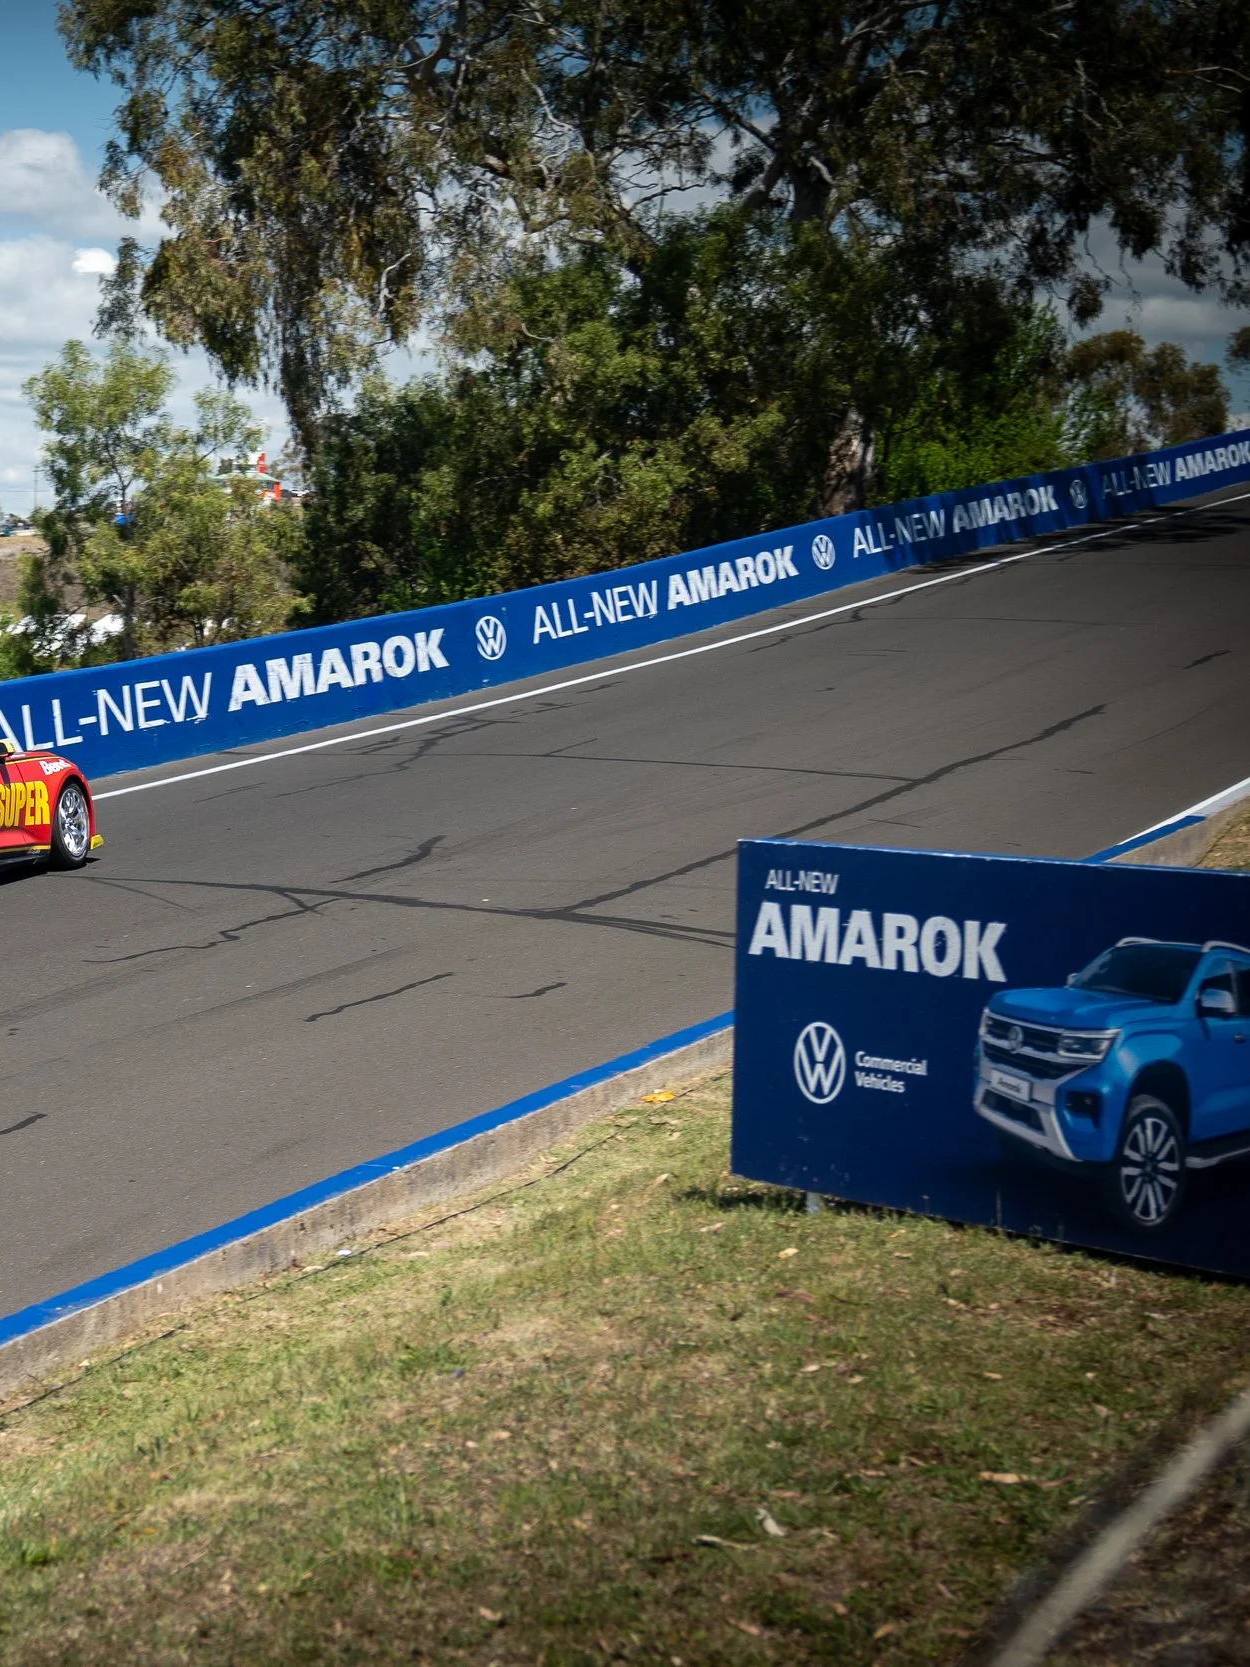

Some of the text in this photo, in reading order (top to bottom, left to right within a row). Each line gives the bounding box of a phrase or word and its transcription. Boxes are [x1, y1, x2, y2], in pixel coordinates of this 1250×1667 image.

[1101, 441, 1250, 499] ALL-NEW AMAROK
[853, 485, 1059, 558] ALL-NEW AMAROK
[533, 545, 799, 645] ALL-NEW AMAROK
[228, 628, 449, 712] AMAROK
[765, 869, 839, 895] ALL-NEW
[749, 901, 1008, 983] AMAROK
[855, 1051, 927, 1076] Commercial
[855, 1071, 906, 1093] Vehicles
